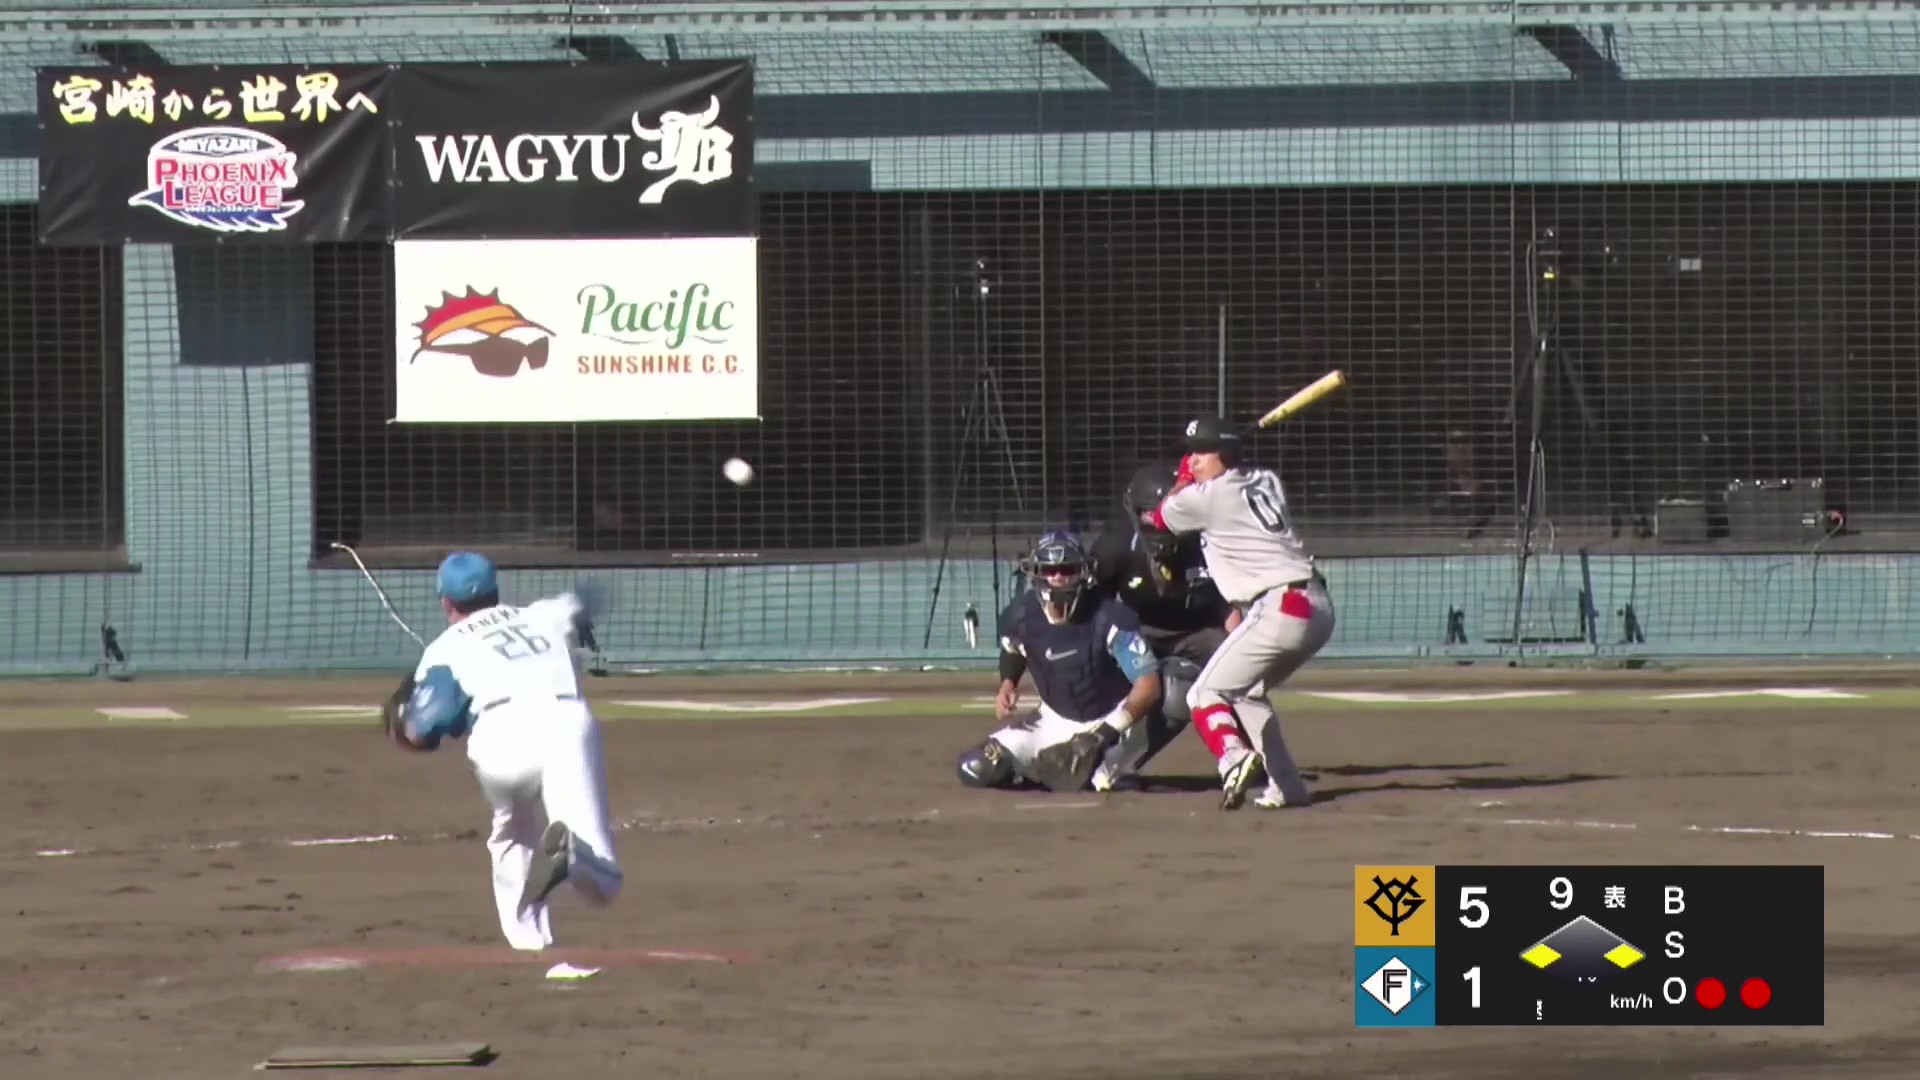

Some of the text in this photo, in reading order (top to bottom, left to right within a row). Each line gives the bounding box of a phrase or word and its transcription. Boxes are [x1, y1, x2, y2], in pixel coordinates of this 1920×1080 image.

[53, 73, 378, 125] 宮崎から世界へ
[176, 136, 258, 154] MIYAZAKI
[415, 133, 631, 183] WAGYU
[155, 158, 288, 185] PHOENIX
[165, 181, 279, 208] LEAGUE
[577, 282, 734, 350] Pacific
[577, 354, 745, 375] SUNSHINE C.C.
[482, 623, 552, 661] 26
